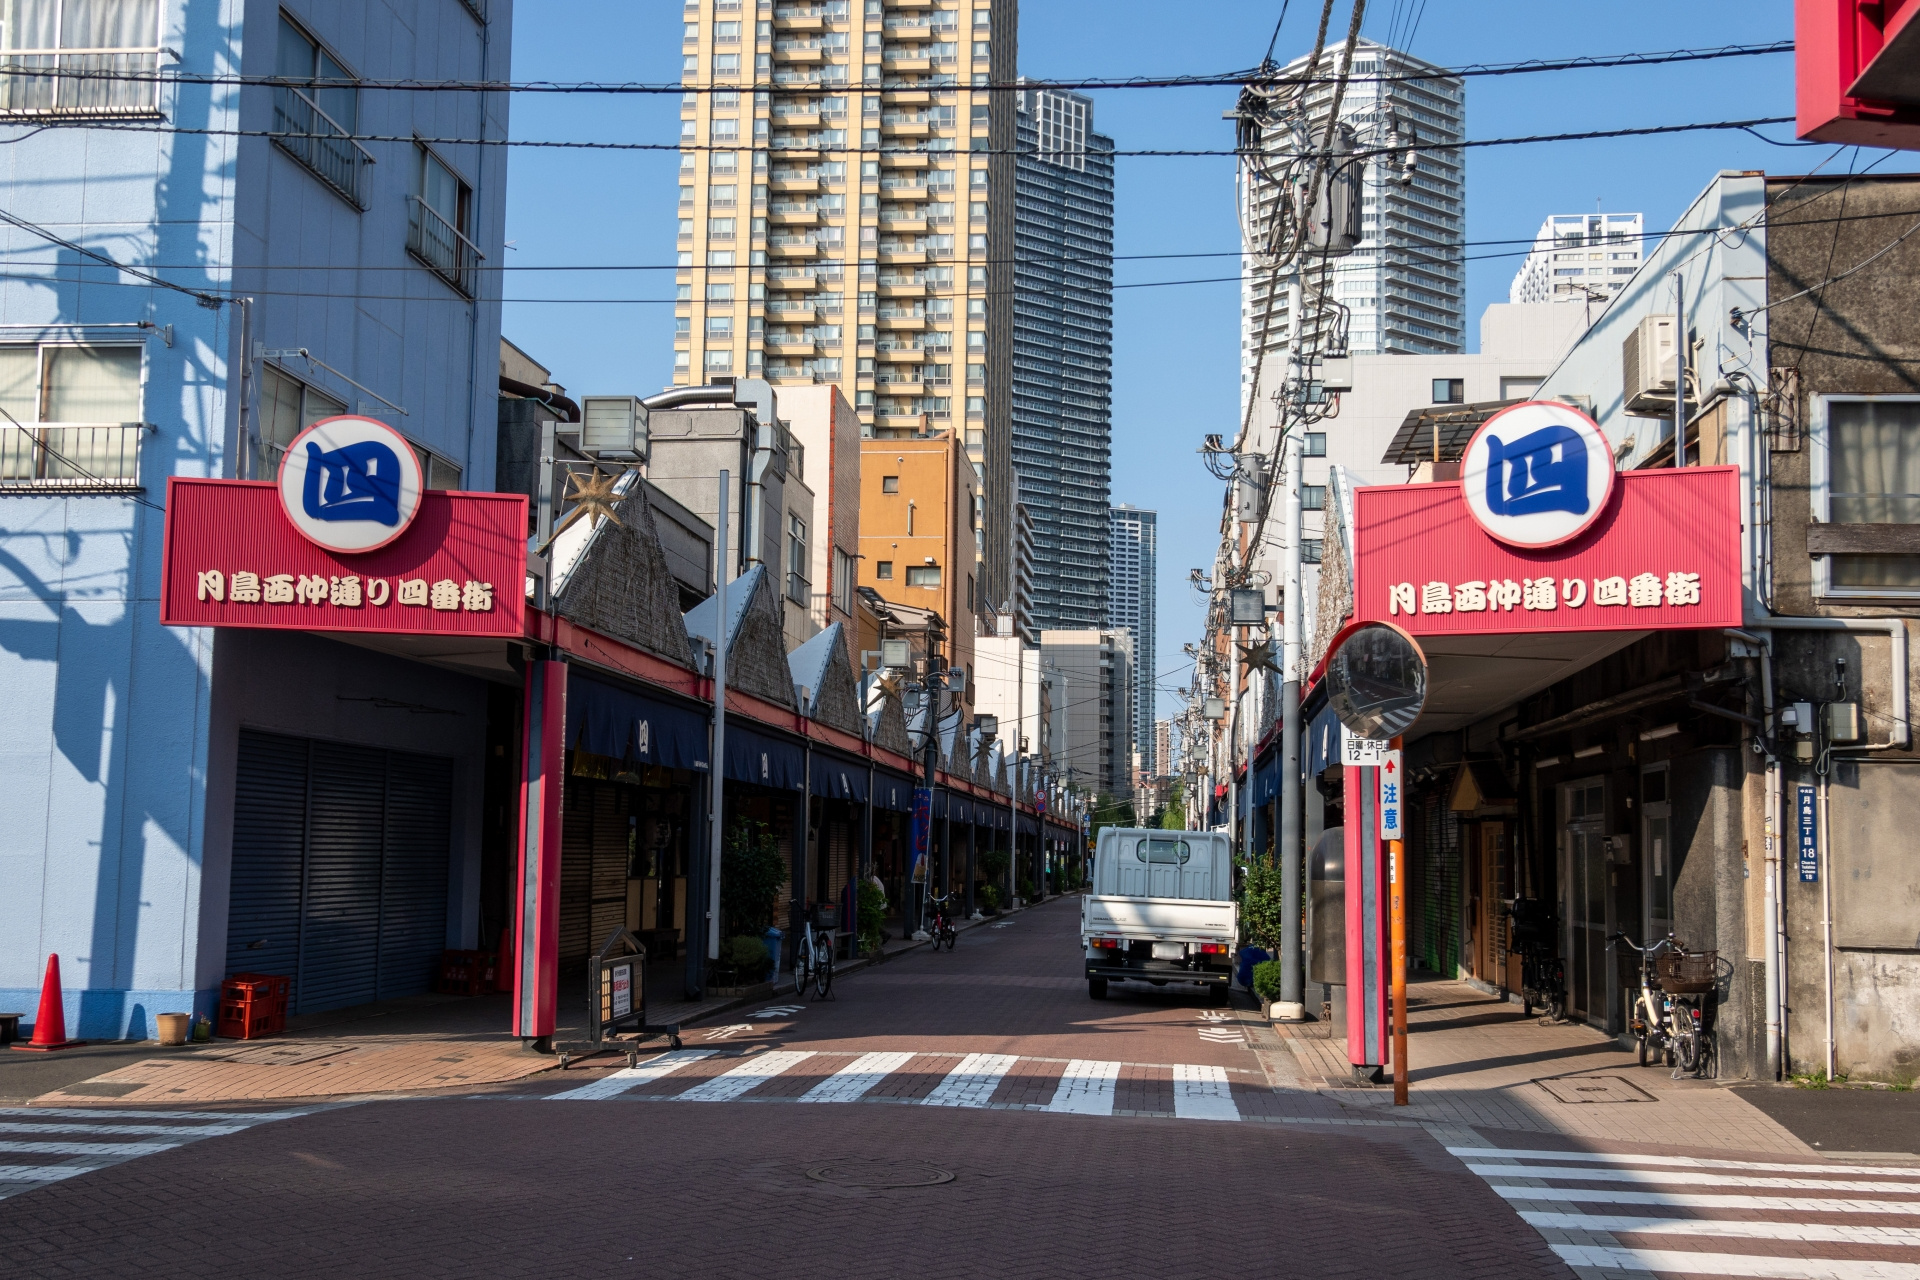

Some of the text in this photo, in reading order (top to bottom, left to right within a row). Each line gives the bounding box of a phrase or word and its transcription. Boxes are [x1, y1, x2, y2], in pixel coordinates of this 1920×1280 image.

[303, 441, 399, 527] 四
[1486, 425, 1590, 516] 四
[197, 569, 493, 611] 月島西仲通り四番街
[1389, 572, 1700, 615] 月島西仲通り四番街
[639, 719, 649, 754] 四
[1383, 783, 1398, 830] 注意
[1803, 796, 1812, 846] 月島三丁目
[1802, 848, 1815, 858] 18
